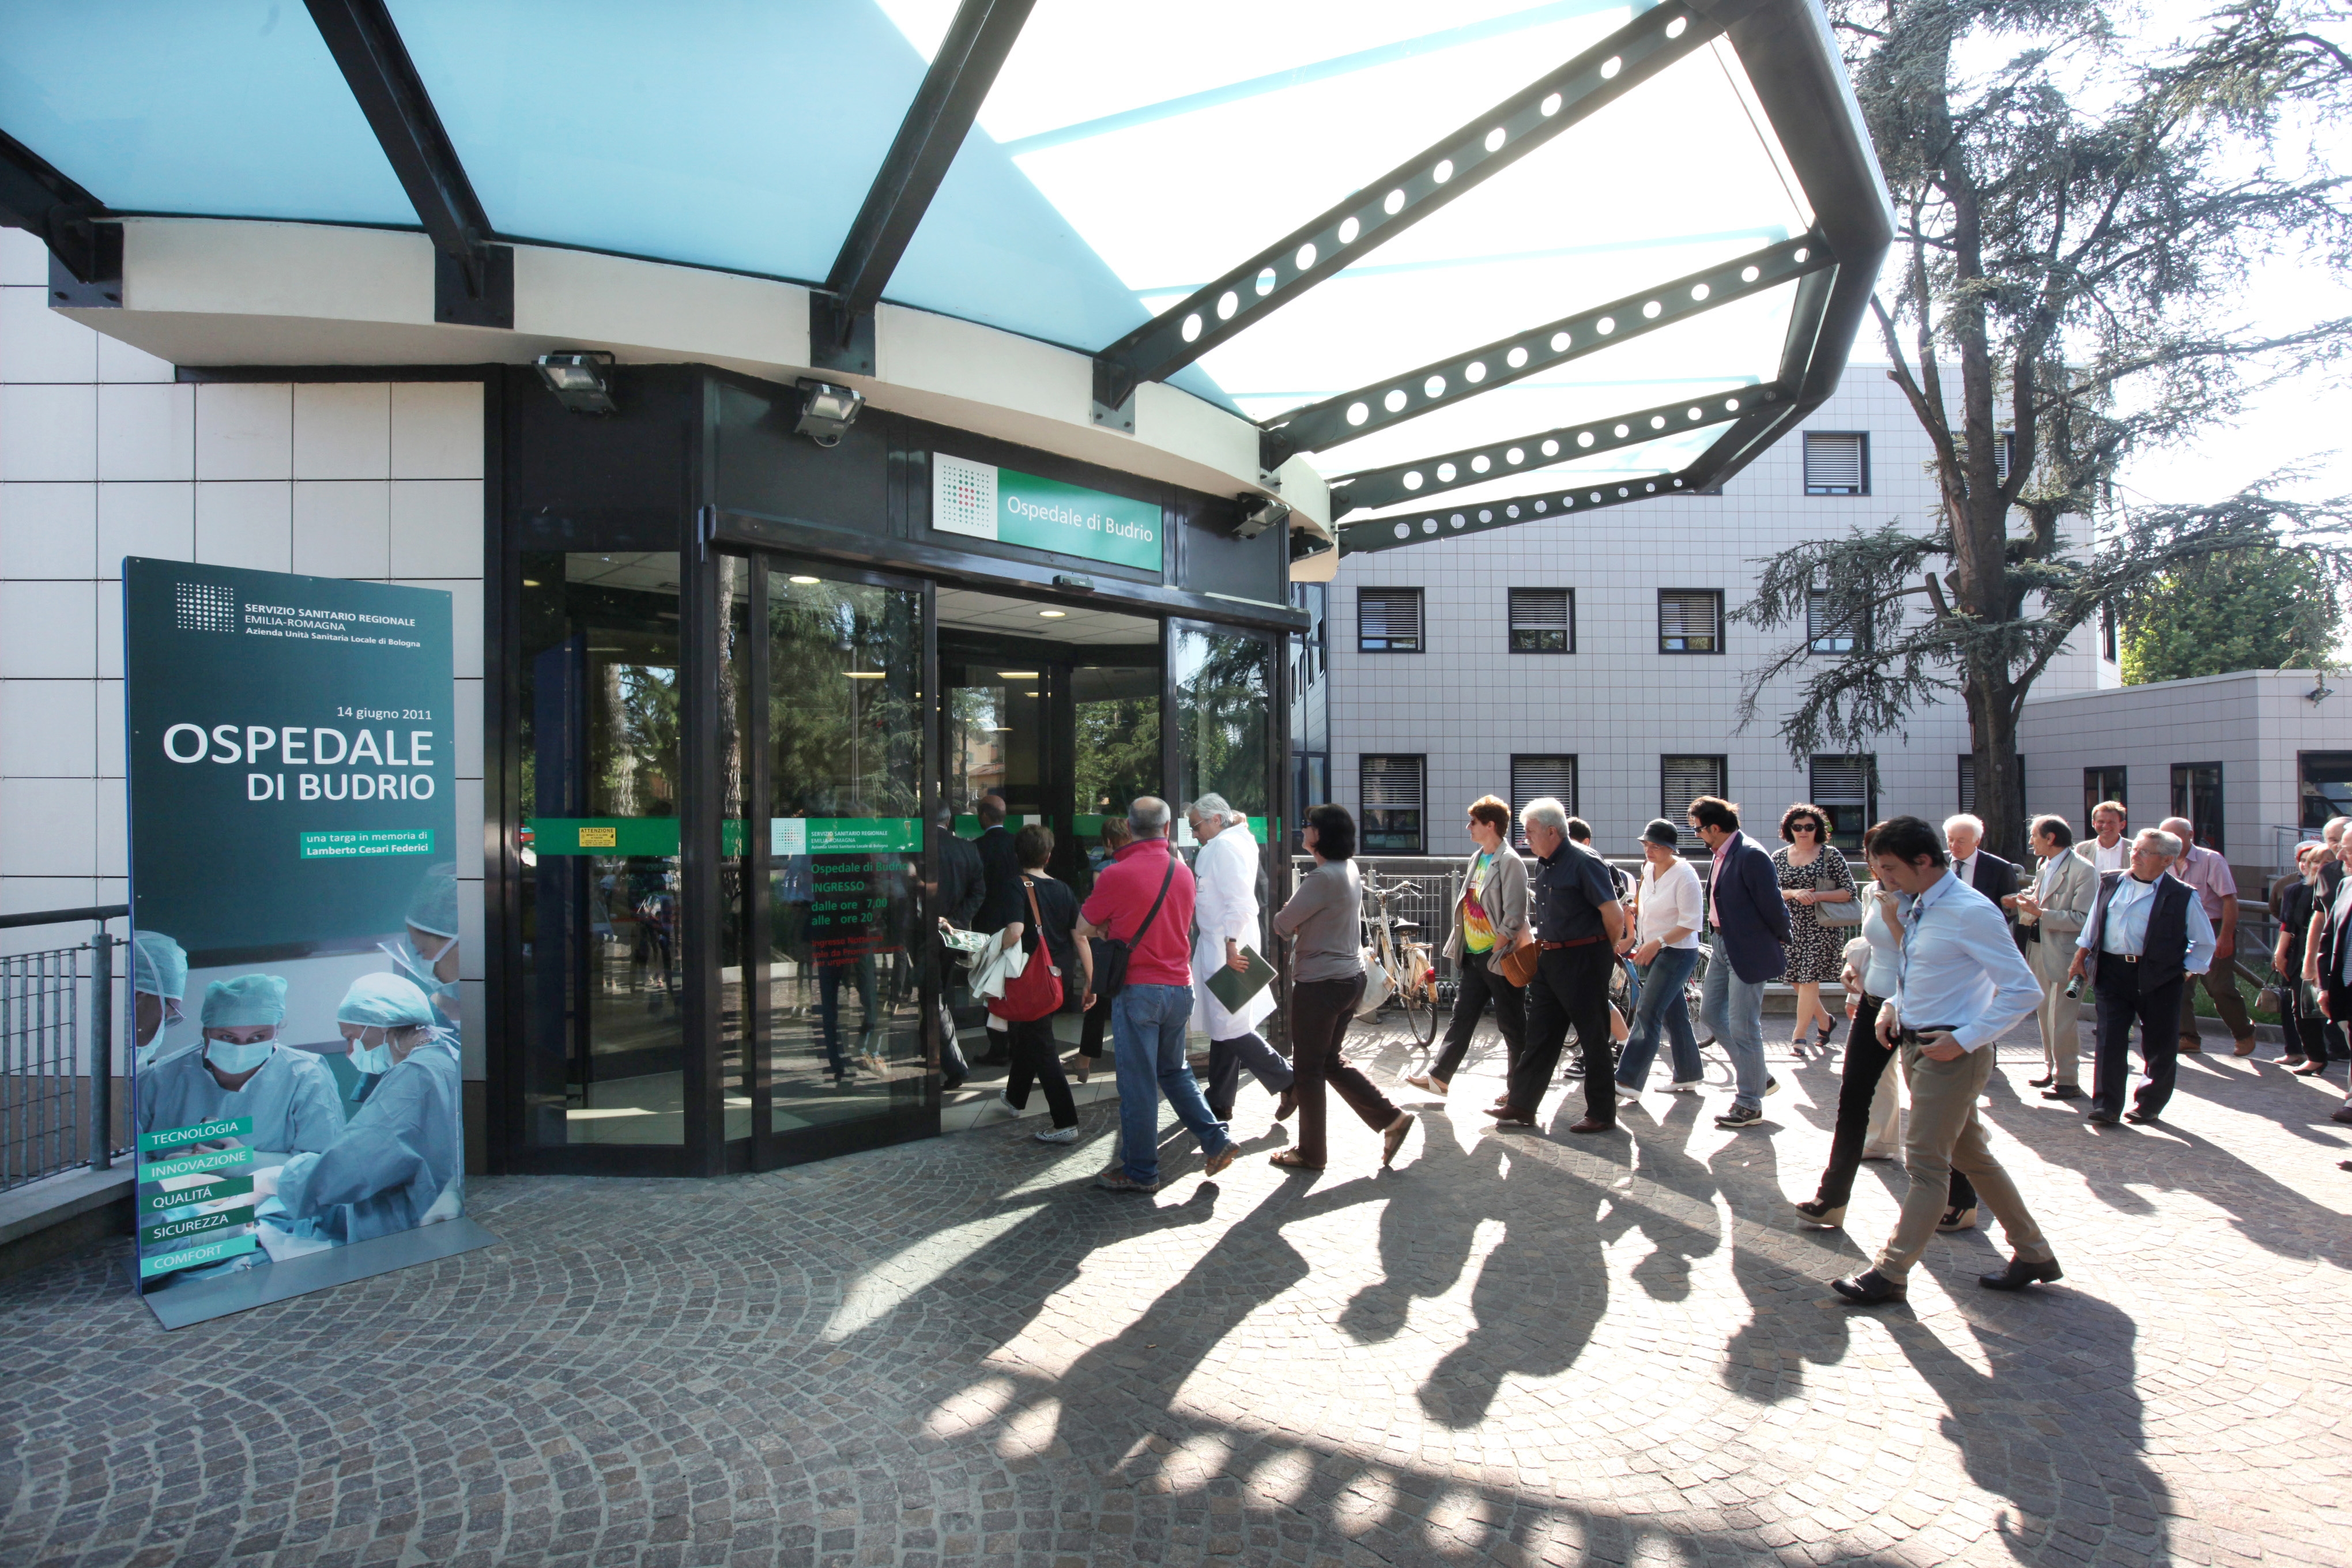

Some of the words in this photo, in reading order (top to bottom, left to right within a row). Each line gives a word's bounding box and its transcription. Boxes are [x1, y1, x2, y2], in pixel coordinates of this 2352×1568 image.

[1007, 496, 1082, 527] Ospedale
[1087, 513, 1100, 530] di
[1106, 518, 1153, 542] Budrio
[245, 604, 295, 617] SERVIZIO
[299, 608, 356, 621] SANITARIO
[359, 615, 416, 627] REGIONALE
[245, 616, 346, 631] EMILIA-ROMAGNA
[246, 627, 282, 638] Azienda
[285, 630, 309, 639] Unità
[311, 632, 349, 642] Sanitaria
[350, 635, 376, 644] Locale
[379, 637, 386, 645] di
[388, 638, 421, 647] Bologna
[337, 707, 353, 718] 14
[356, 708, 398, 721] giugno
[402, 709, 432, 720] 2011
[163, 723, 434, 766] OSPEDALE
[248, 773, 285, 801] DI
[300, 773, 435, 801] BUDRIO
[307, 835, 327, 843] una
[329, 834, 356, 844] targa
[359, 833, 368, 841] in
[372, 832, 416, 840] memoria
[307, 845, 357, 855] Lamberto
[359, 845, 389, 854] Cesari
[391, 843, 428, 853] Federici
[811, 862, 861, 875] Ospedale
[864, 862, 873, 872] di
[876, 861, 909, 872] Budrio
[812, 881, 865, 892] INGRESSO
[812, 900, 838, 912] dalle
[840, 900, 858, 910] ore
[866, 898, 888, 909] 7,00
[812, 916, 831, 926] alle
[840, 915, 859, 924] ore
[861, 913, 873, 923] 20
[152, 1122, 238, 1144] TECNOLOGIA
[152, 1151, 246, 1177] INNOVAZIONE
[153, 1186, 212, 1208] QUALITÁ
[153, 1214, 228, 1239] SICUREZZA
[154, 1245, 223, 1269] COMFORT
